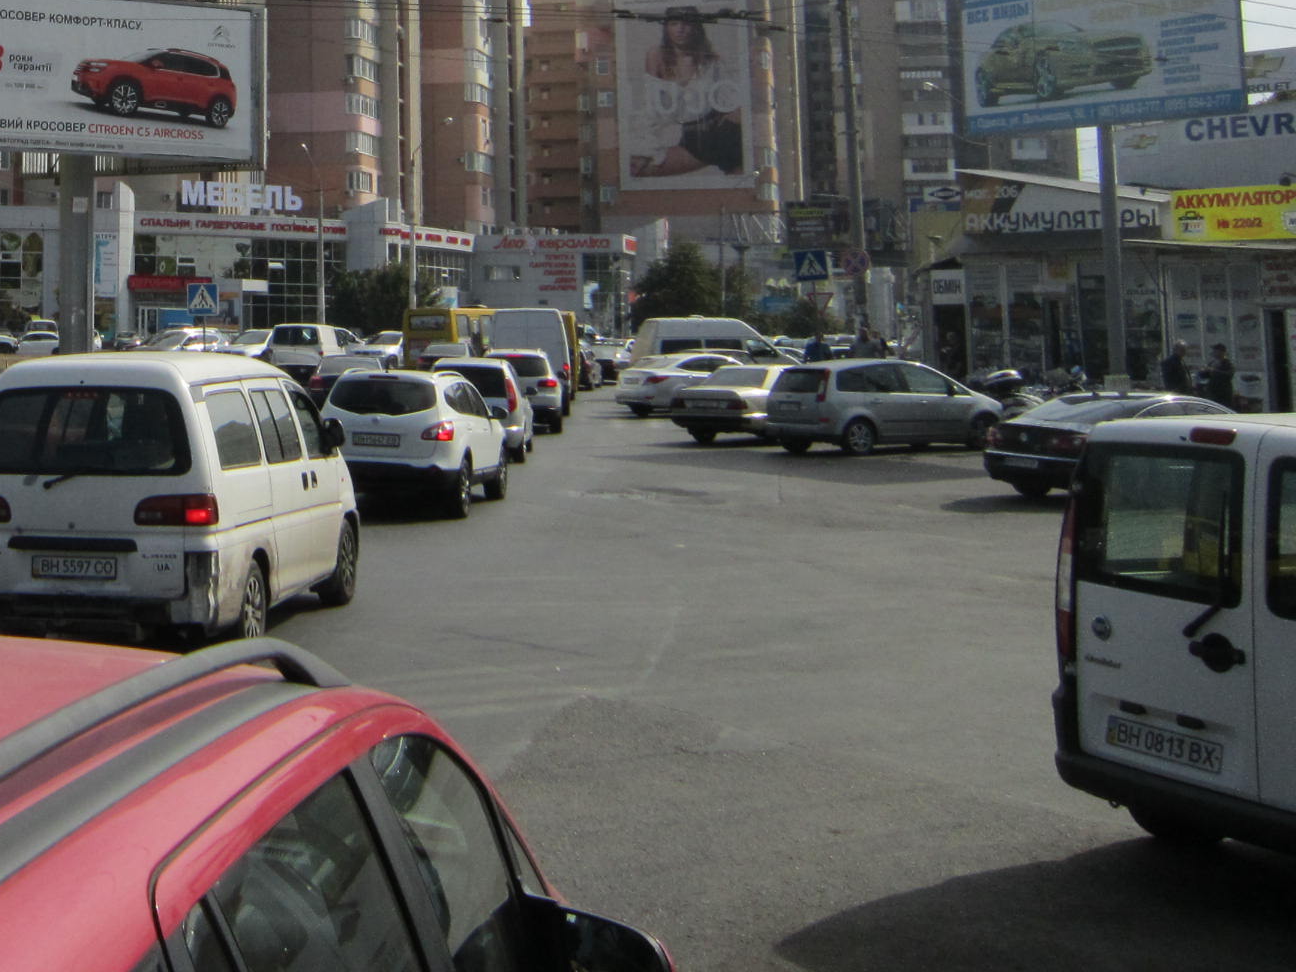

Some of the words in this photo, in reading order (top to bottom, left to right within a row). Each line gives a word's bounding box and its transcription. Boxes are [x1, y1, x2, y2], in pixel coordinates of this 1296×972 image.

[9, 53, 33, 63] роки
[13, 62, 52, 73] гарантії
[26, 120, 86, 133] КРОСОВЕР
[136, 126, 151, 138] C5
[154, 128, 204, 140] AIRCROSS
[1185, 112, 1296, 141] CHEVR
[182, 180, 302, 211] МЕБЕЛЬ
[140, 217, 191, 228] СПАЛЬНИ
[966, 208, 1159, 233] АККУМУЛЯТРЫ
[537, 235, 611, 251] кераміка
[41, 559, 60, 573] BH
[63, 560, 91, 574] 5597
[156, 563, 170, 572] UA
[1117, 723, 1141, 747] BH
[1145, 730, 1184, 759] 0813
[1188, 741, 1217, 769] BX
